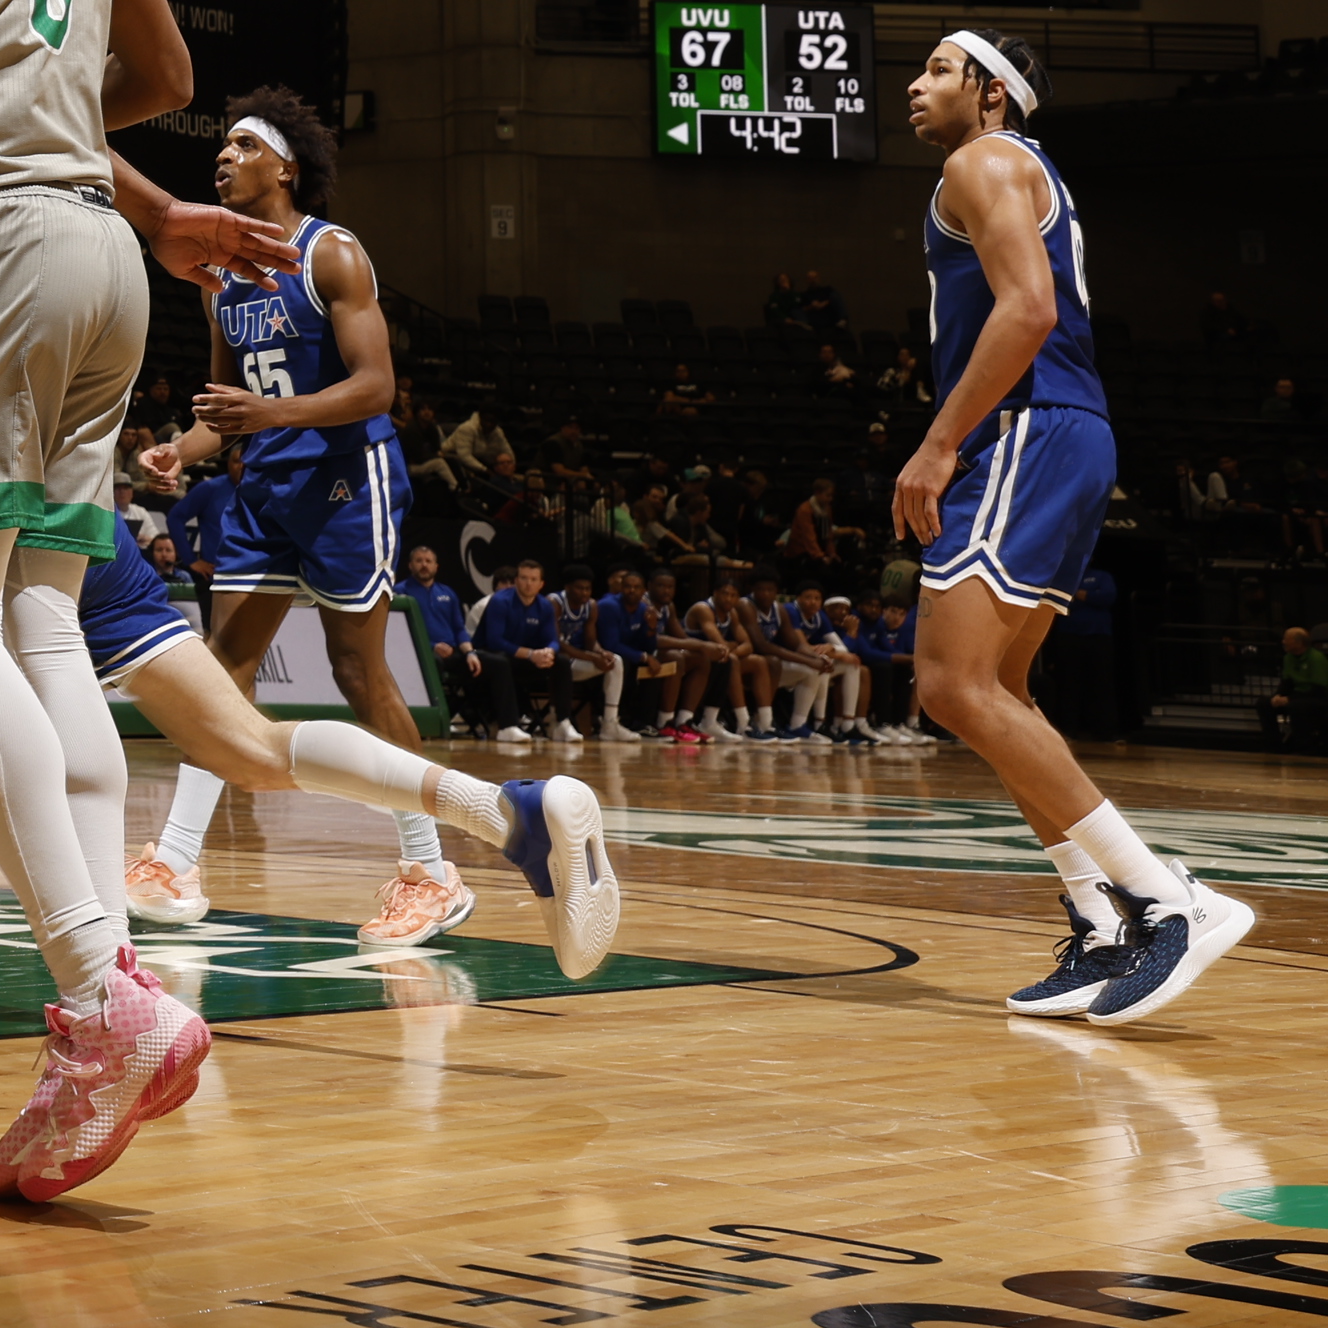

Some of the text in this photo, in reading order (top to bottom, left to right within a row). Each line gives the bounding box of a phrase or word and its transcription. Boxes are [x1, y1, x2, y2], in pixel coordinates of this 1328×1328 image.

[189, 4, 235, 36] WON!
[680, 7, 731, 28] UVU
[797, 10, 846, 31] UTA
[680, 30, 732, 68] 67
[797, 33, 849, 71] 52
[676, 73, 744, 92] 3 08
[791, 76, 859, 96] 2 10
[669, 92, 750, 110] TOL FLS
[784, 95, 865, 114] TOL FLS
[729, 116, 803, 155] 4:42
[497, 220, 508, 236] 9
[220, 296, 299, 347] UTA
